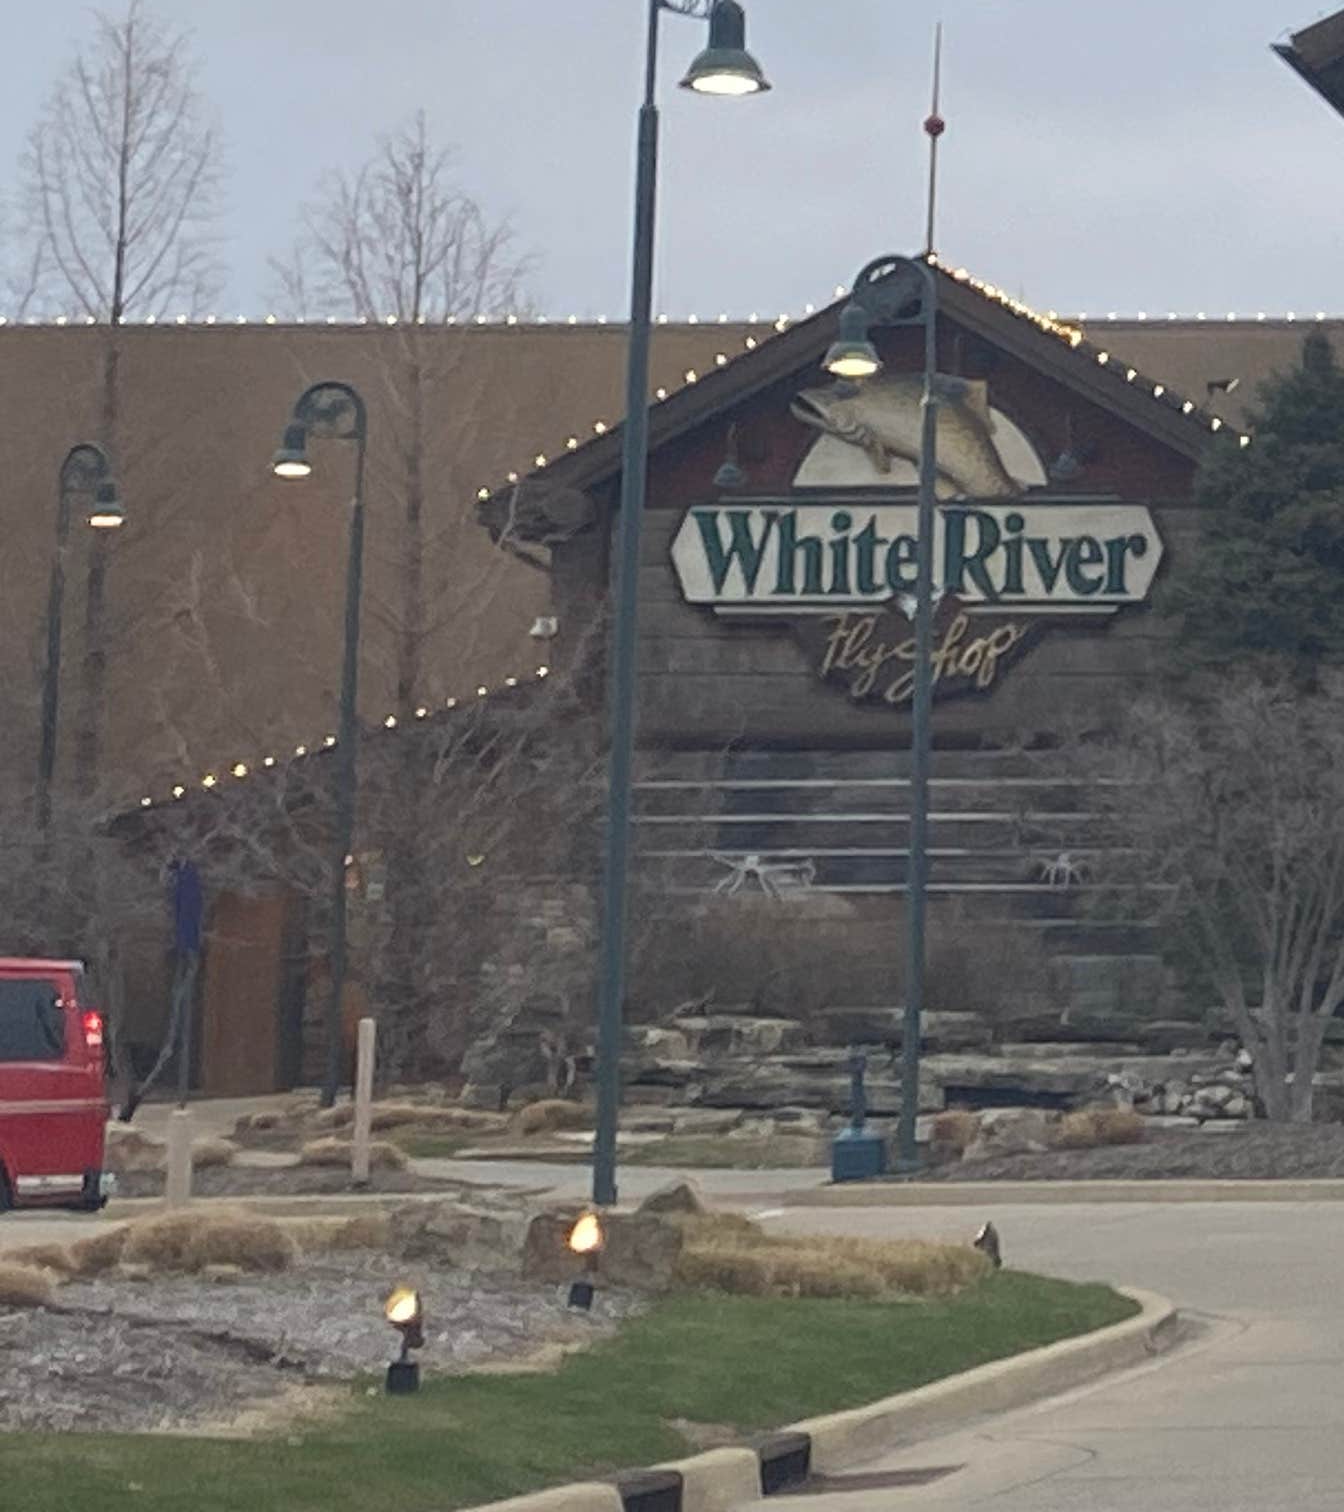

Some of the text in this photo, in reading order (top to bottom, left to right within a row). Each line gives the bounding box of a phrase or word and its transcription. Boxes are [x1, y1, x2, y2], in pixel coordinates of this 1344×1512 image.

[691, 508, 1148, 597] White River
[821, 613, 888, 697] Fly
